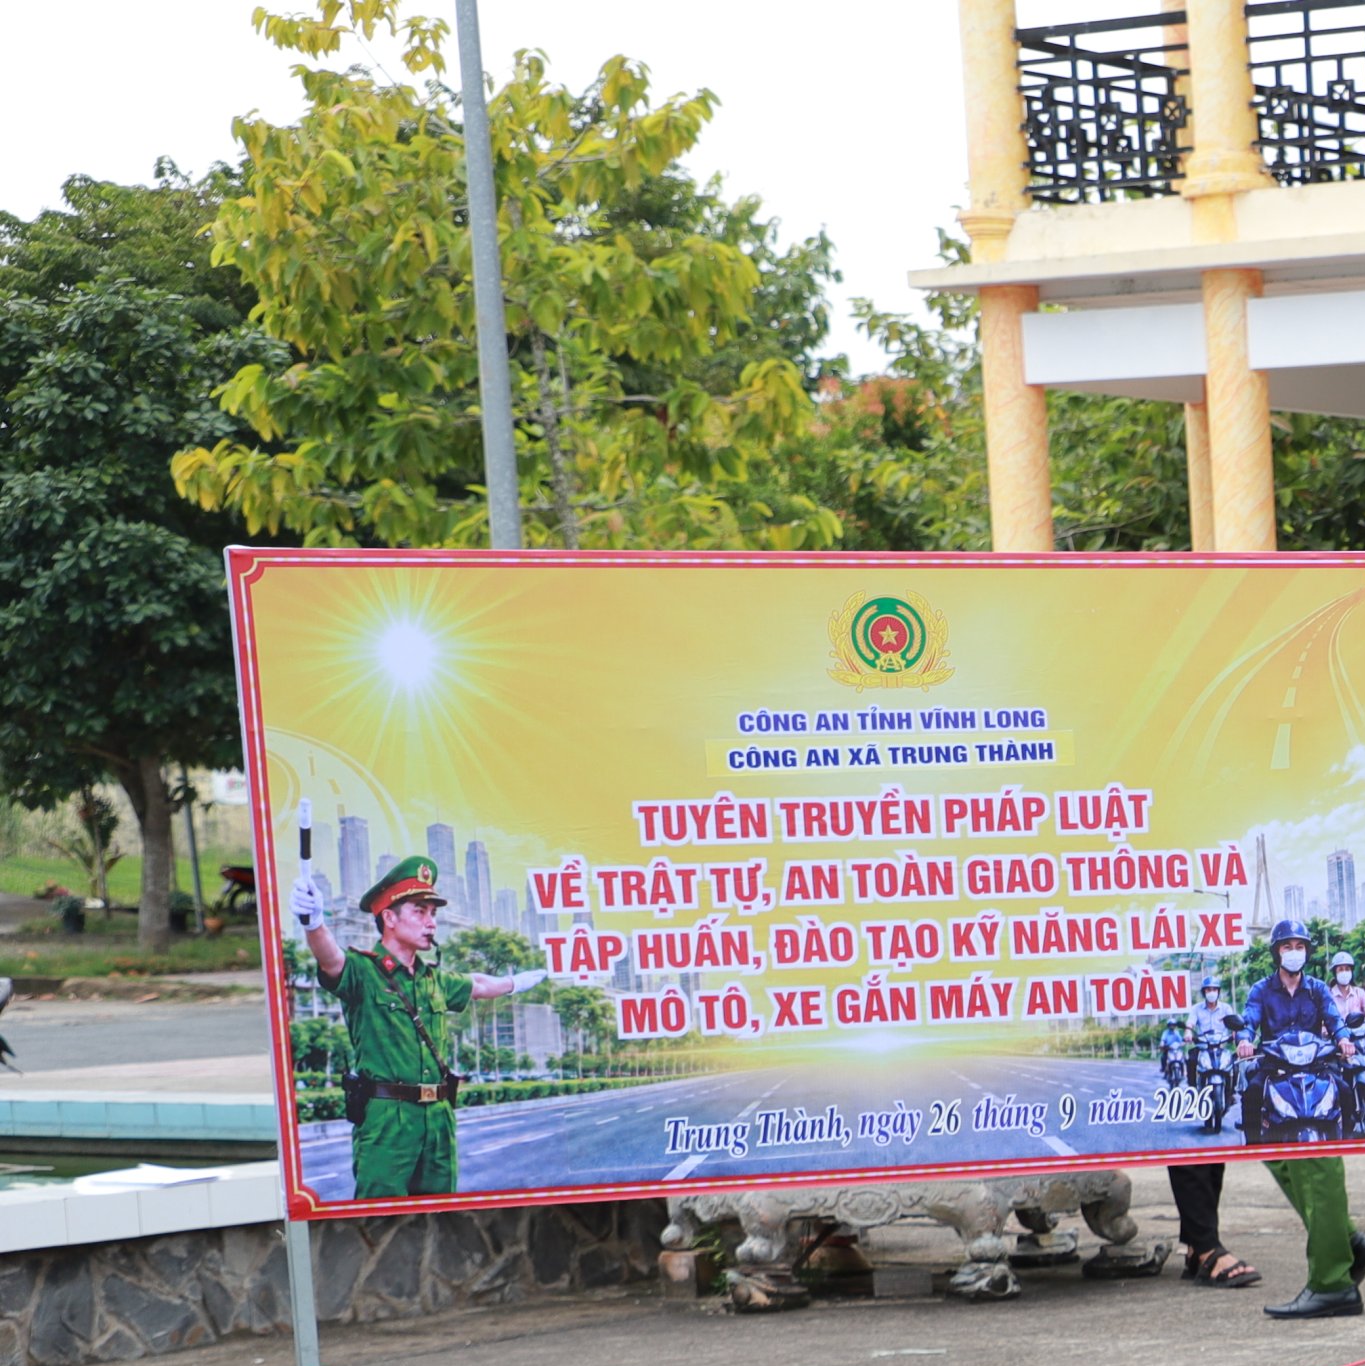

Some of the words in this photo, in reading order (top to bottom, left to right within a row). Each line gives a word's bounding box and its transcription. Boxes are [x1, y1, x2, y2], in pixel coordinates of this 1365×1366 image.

[739, 710, 807, 732] CÔNG
[816, 712, 849, 731] AN
[857, 706, 912, 730] TỈNH
[920, 708, 976, 730] VĨNH
[984, 709, 1046, 729] LONG
[728, 747, 797, 769] CÔNG
[805, 748, 840, 768] AN
[848, 743, 881, 766] XÃ
[888, 745, 968, 765] TRUNG
[975, 741, 1054, 762] THÀNH
[637, 795, 768, 841] TUYÊN
[780, 788, 931, 838] TRUYỀN
[944, 789, 1046, 833] PHÁP
[1059, 787, 1148, 837] LUẬT
[534, 859, 585, 909] VỀ
[597, 862, 697, 913] TRẬT
[710, 863, 771, 911] TỰ,
[785, 864, 840, 901] AN
[852, 854, 953, 899] TOÀN
[968, 857, 1055, 895] GIAO
[1066, 847, 1190, 892] THÔNG
[1200, 844, 1248, 887] VÀ
[545, 928, 622, 981] TẬP
[638, 918, 762, 971] HUẤN,
[774, 920, 854, 964] ĐÀO
[867, 922, 939, 968] TẠO
[952, 914, 1000, 957] KỸ
[1013, 911, 1118, 954] NĂNG
[1130, 907, 1187, 950] LÁI
[1199, 912, 1245, 948] XE
[621, 988, 685, 1034] MÔ
[700, 986, 760, 1034] TÔ,
[773, 990, 824, 1028] XE
[836, 974, 916, 1024] GẮN
[930, 976, 1014, 1020] MÁY
[1027, 980, 1079, 1016] AN
[1090, 969, 1187, 1013] TOÀN
[667, 1119, 748, 1156] Trung
[758, 1107, 850, 1146] Thành,
[860, 1101, 922, 1143] ngày
[929, 1101, 960, 1135] 26
[973, 1096, 1046, 1136] tháng
[1060, 1095, 1075, 1128] 9
[1089, 1088, 1145, 1124] năm
[1152, 1086, 1213, 1123] 2026
